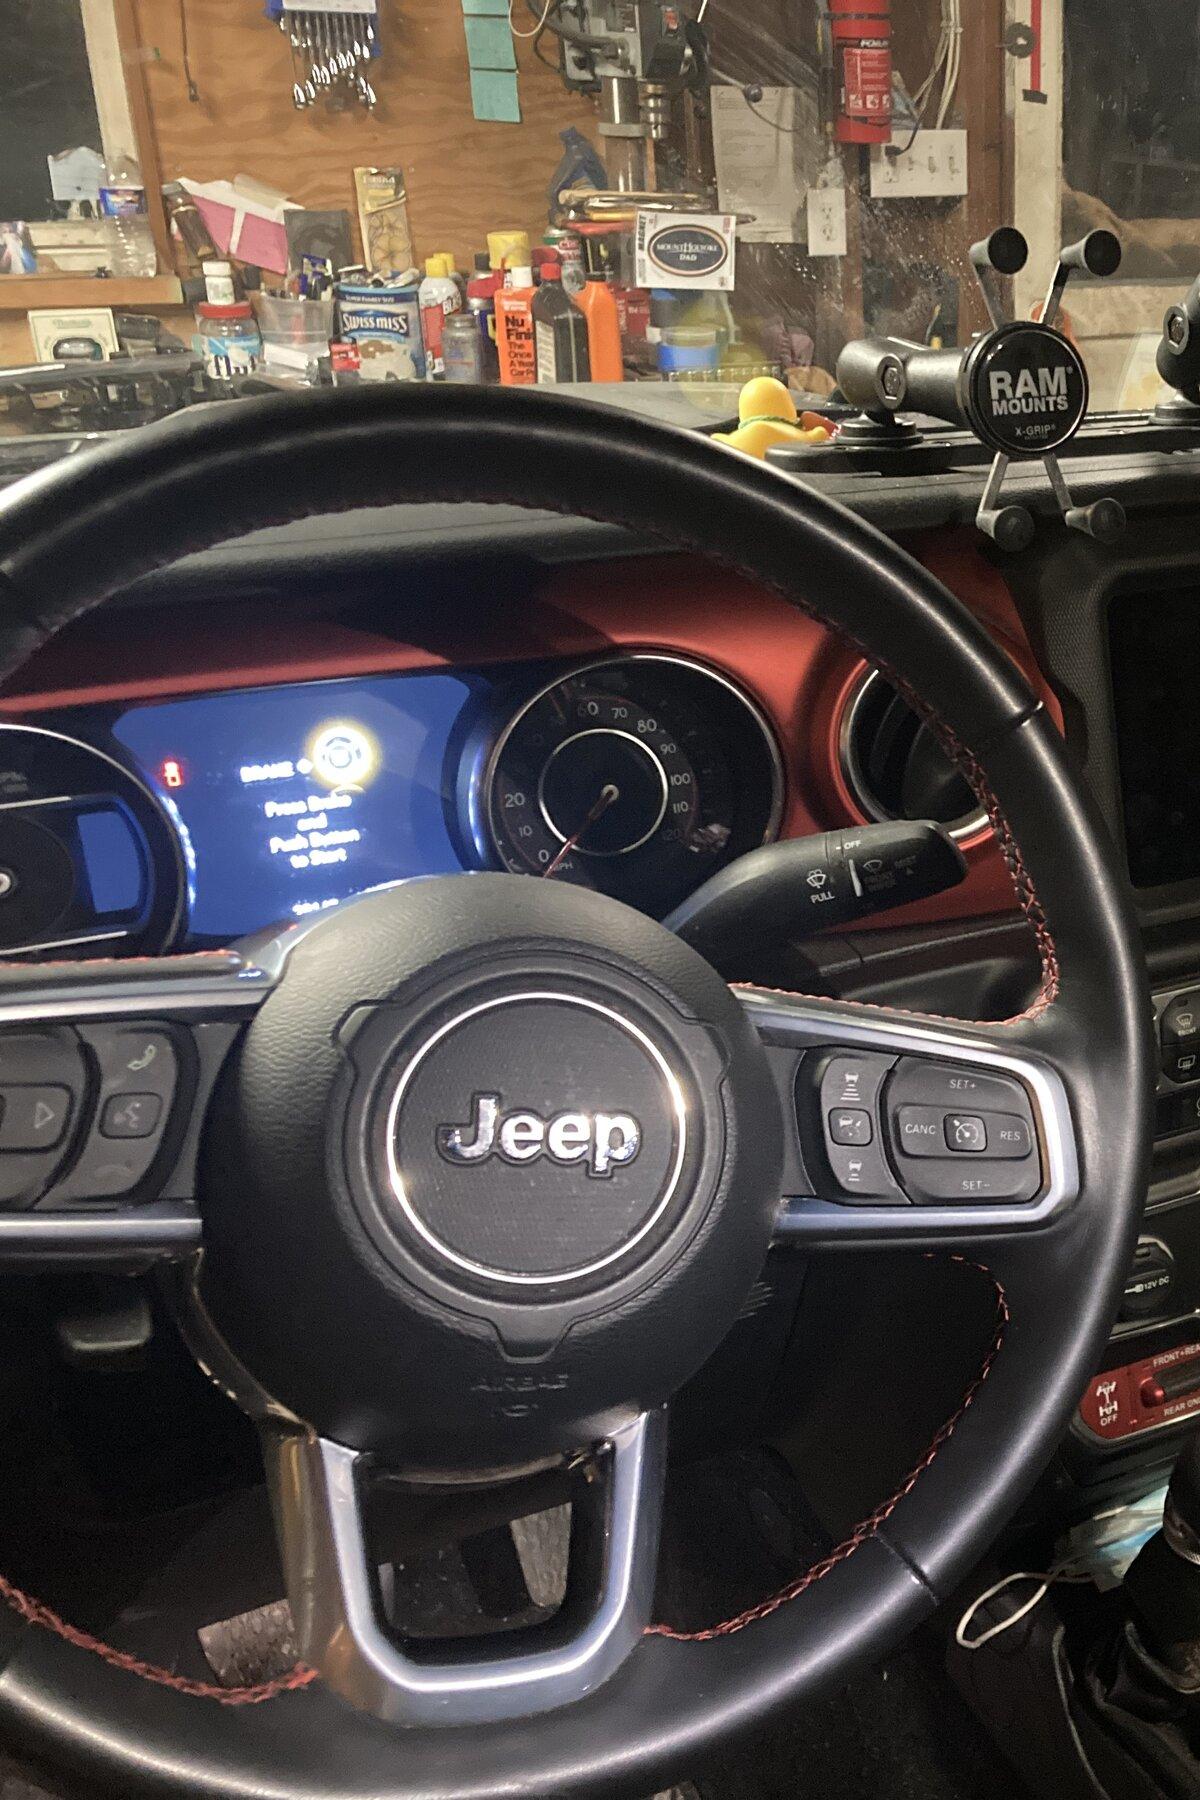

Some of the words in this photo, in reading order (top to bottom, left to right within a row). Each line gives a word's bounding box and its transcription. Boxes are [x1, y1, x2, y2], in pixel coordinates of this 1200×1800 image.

[504, 314, 525, 328] Nu
[506, 327, 533, 340] Fini
[989, 366, 1068, 400] RAM
[992, 395, 1069, 416] MOUNTS
[611, 707, 628, 719] 70
[637, 719, 657, 733] 80
[659, 742, 677, 754] 90
[670, 773, 691, 786] 100
[504, 791, 527, 808] 20
[672, 800, 690, 813] 110
[518, 825, 534, 838] 10
[844, 839, 862, 850] OFF
[538, 849, 550, 863] 0
[810, 890, 836, 904] PULL
[440, 1097, 641, 1175] Jeep
[904, 1123, 936, 1136] CANC
[1000, 1130, 1021, 1141] RES
[1144, 1279, 1158, 1290] 12V
[1158, 1275, 1170, 1286] DC
[1163, 1402, 1186, 1416] REAR
[1100, 1414, 1118, 1427] OFF
